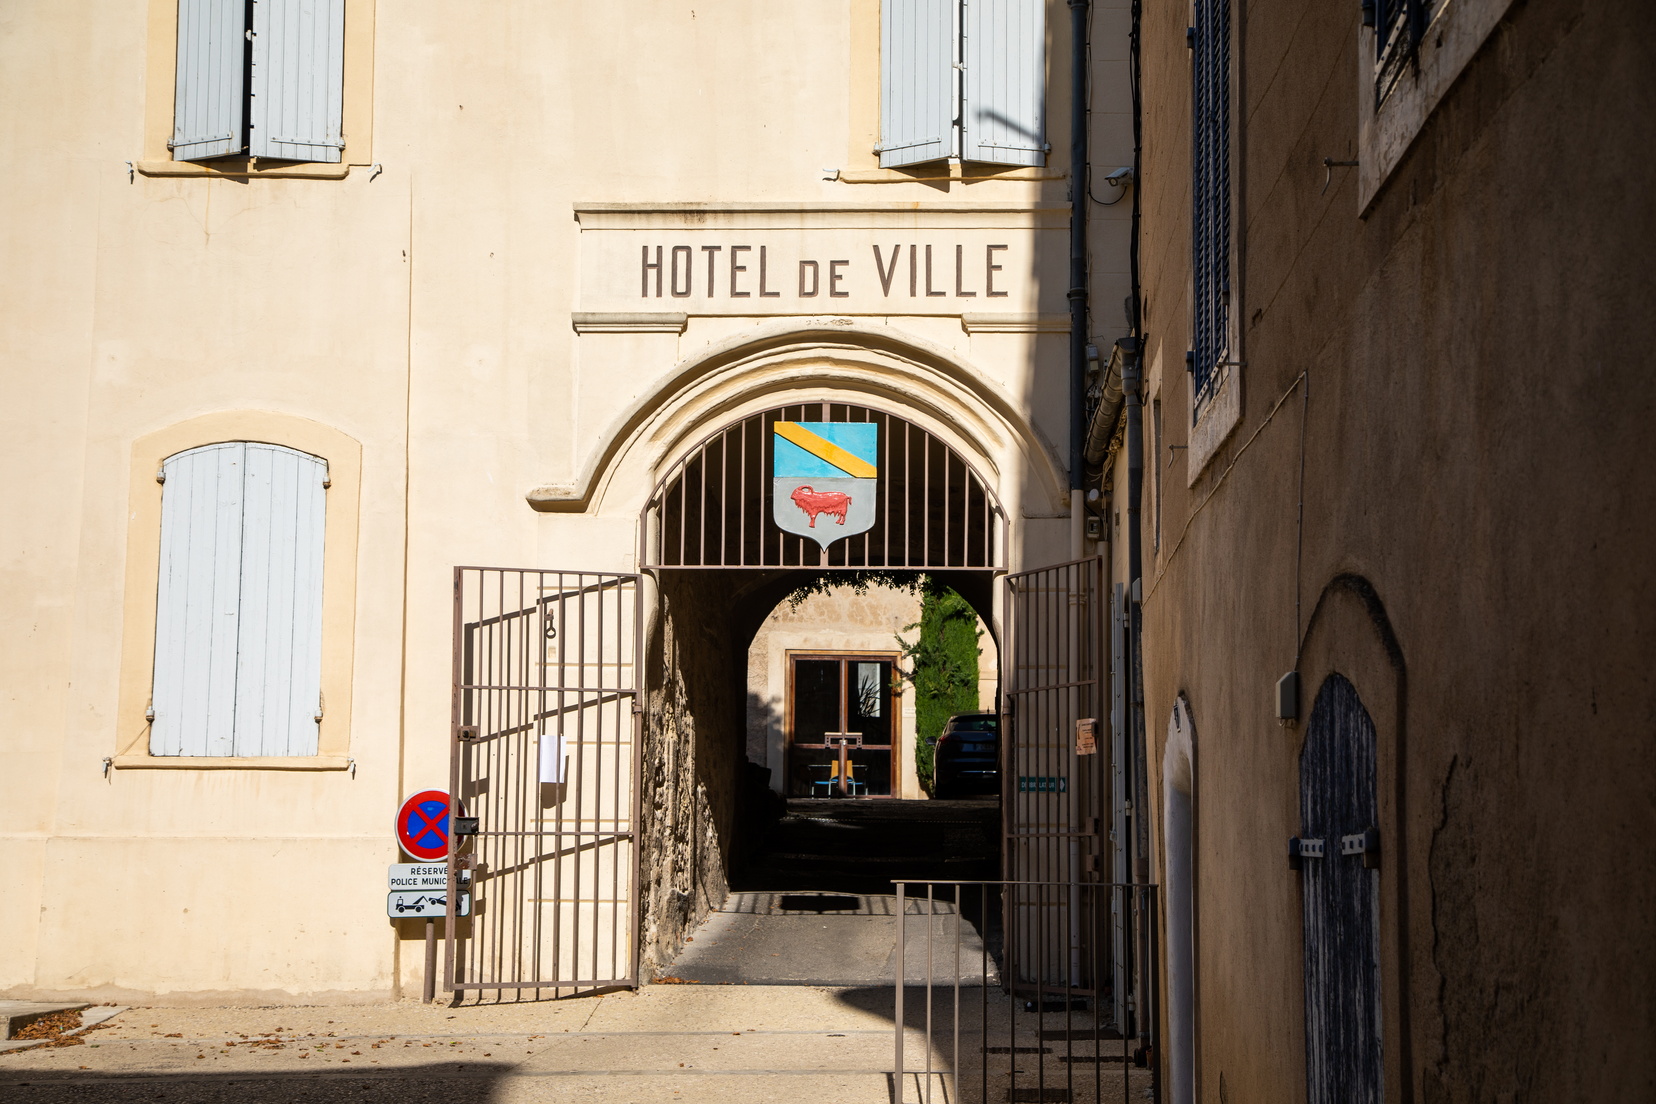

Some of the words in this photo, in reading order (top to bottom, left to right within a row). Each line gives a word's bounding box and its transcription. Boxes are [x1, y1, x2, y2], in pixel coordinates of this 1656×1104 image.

[641, 245, 781, 298] HOTEL
[799, 260, 849, 298] DE
[872, 244, 1008, 298] VILLE
[411, 866, 448, 875] RÉSERVÉ
[391, 878, 418, 886] POLICE
[422, 877, 468, 885] MUNICLE
